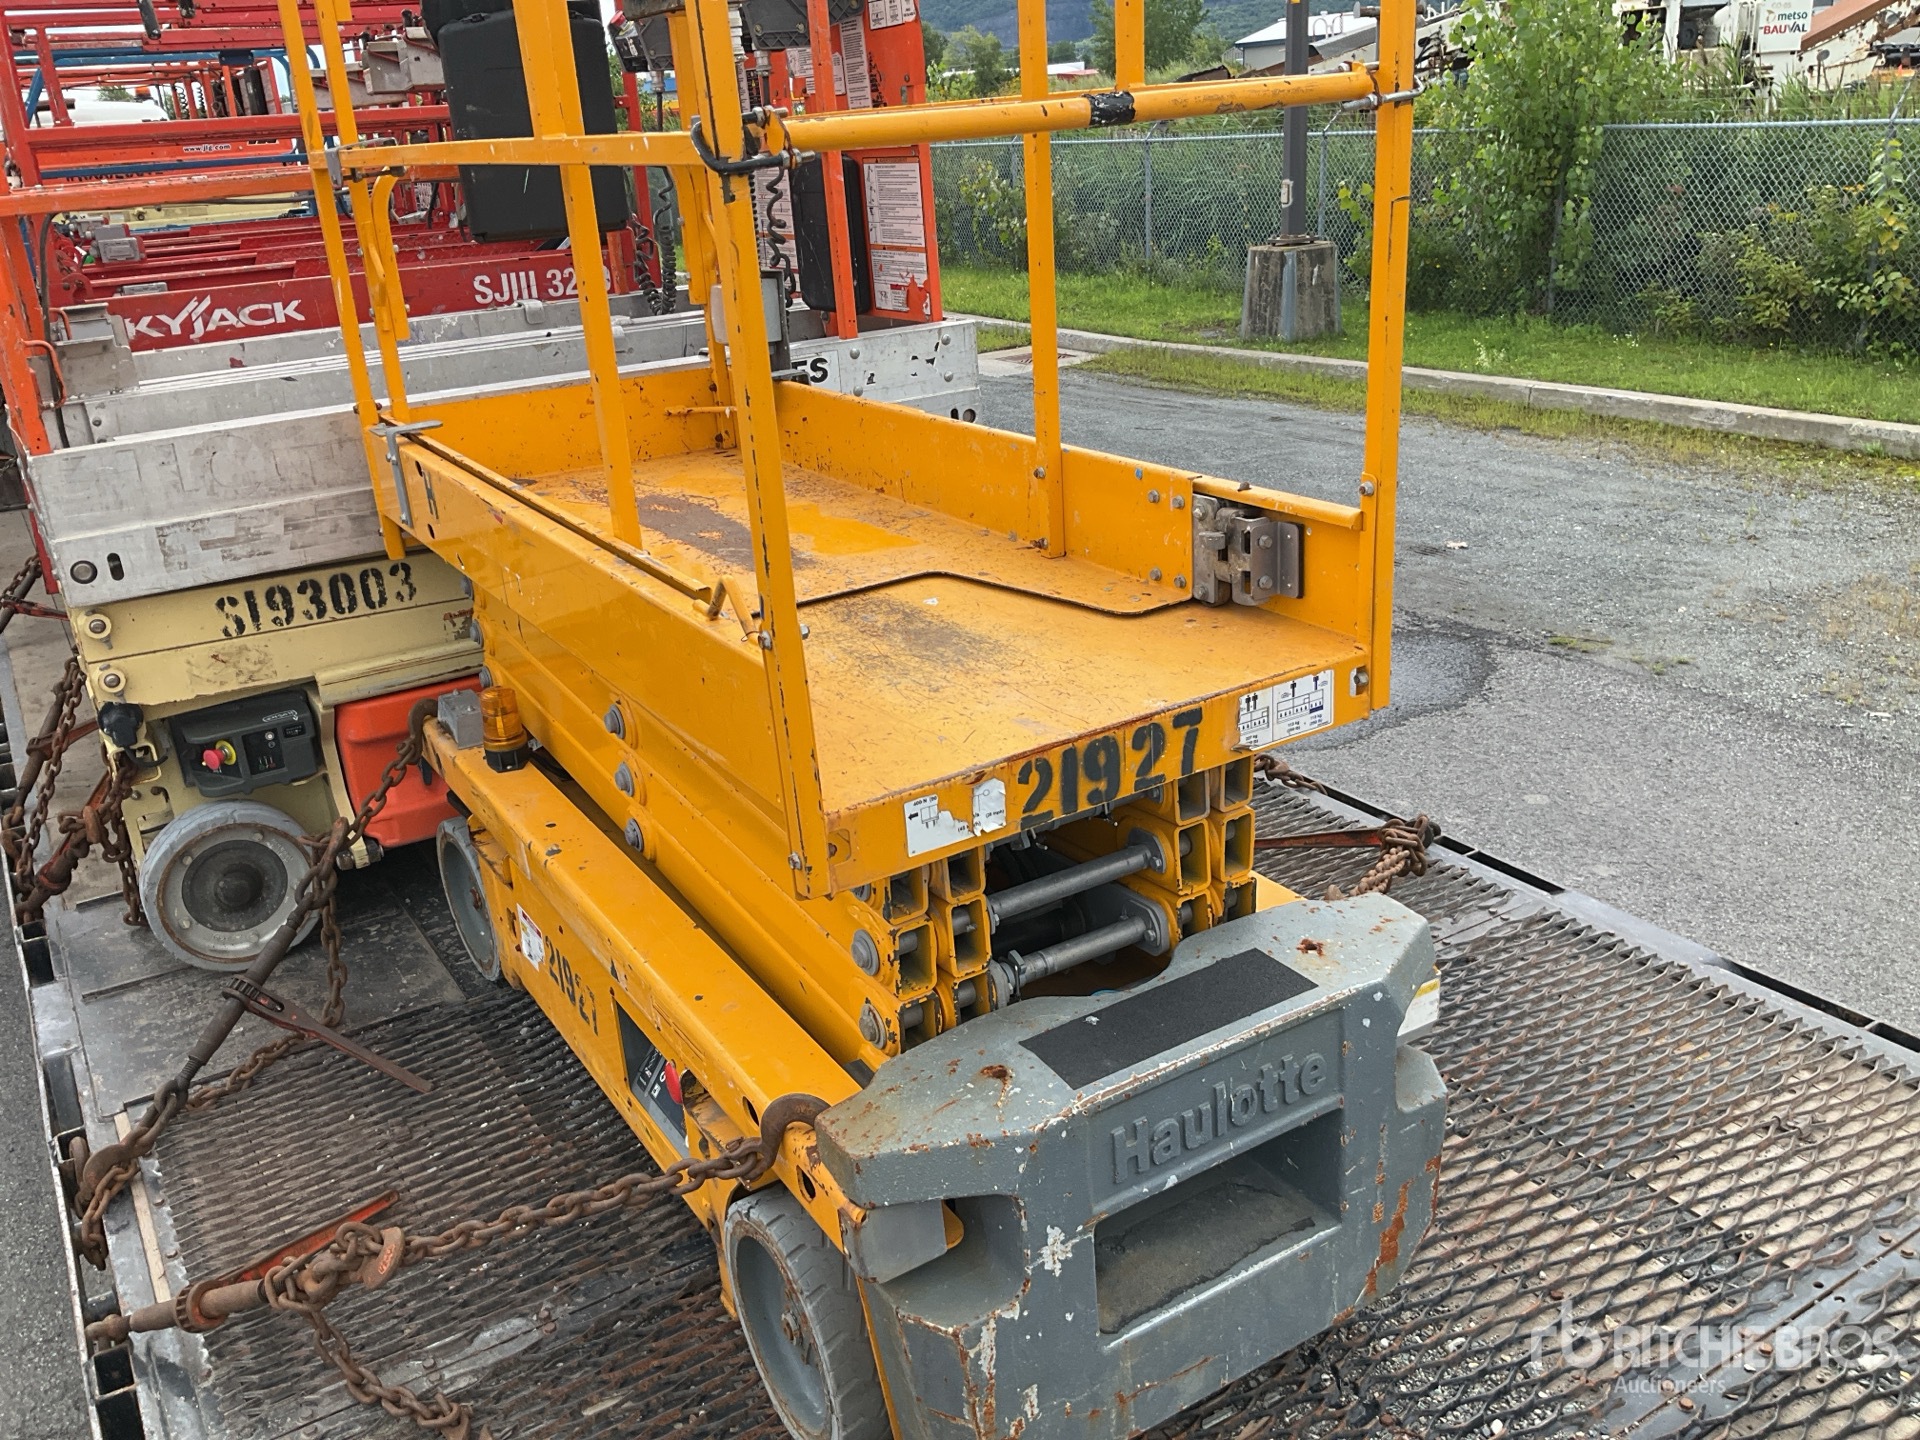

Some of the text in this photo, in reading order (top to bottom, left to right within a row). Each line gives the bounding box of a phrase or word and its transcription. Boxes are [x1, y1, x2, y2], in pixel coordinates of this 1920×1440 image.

[1763, 22, 1808, 35] BAUVAL
[1777, 11, 1808, 21] metso
[183, 143, 231, 153] www.jlg.com
[124, 294, 306, 340] KYJACK
[1018, 706, 1203, 821] 21927
[1111, 1052, 1328, 1184] Haulotte
